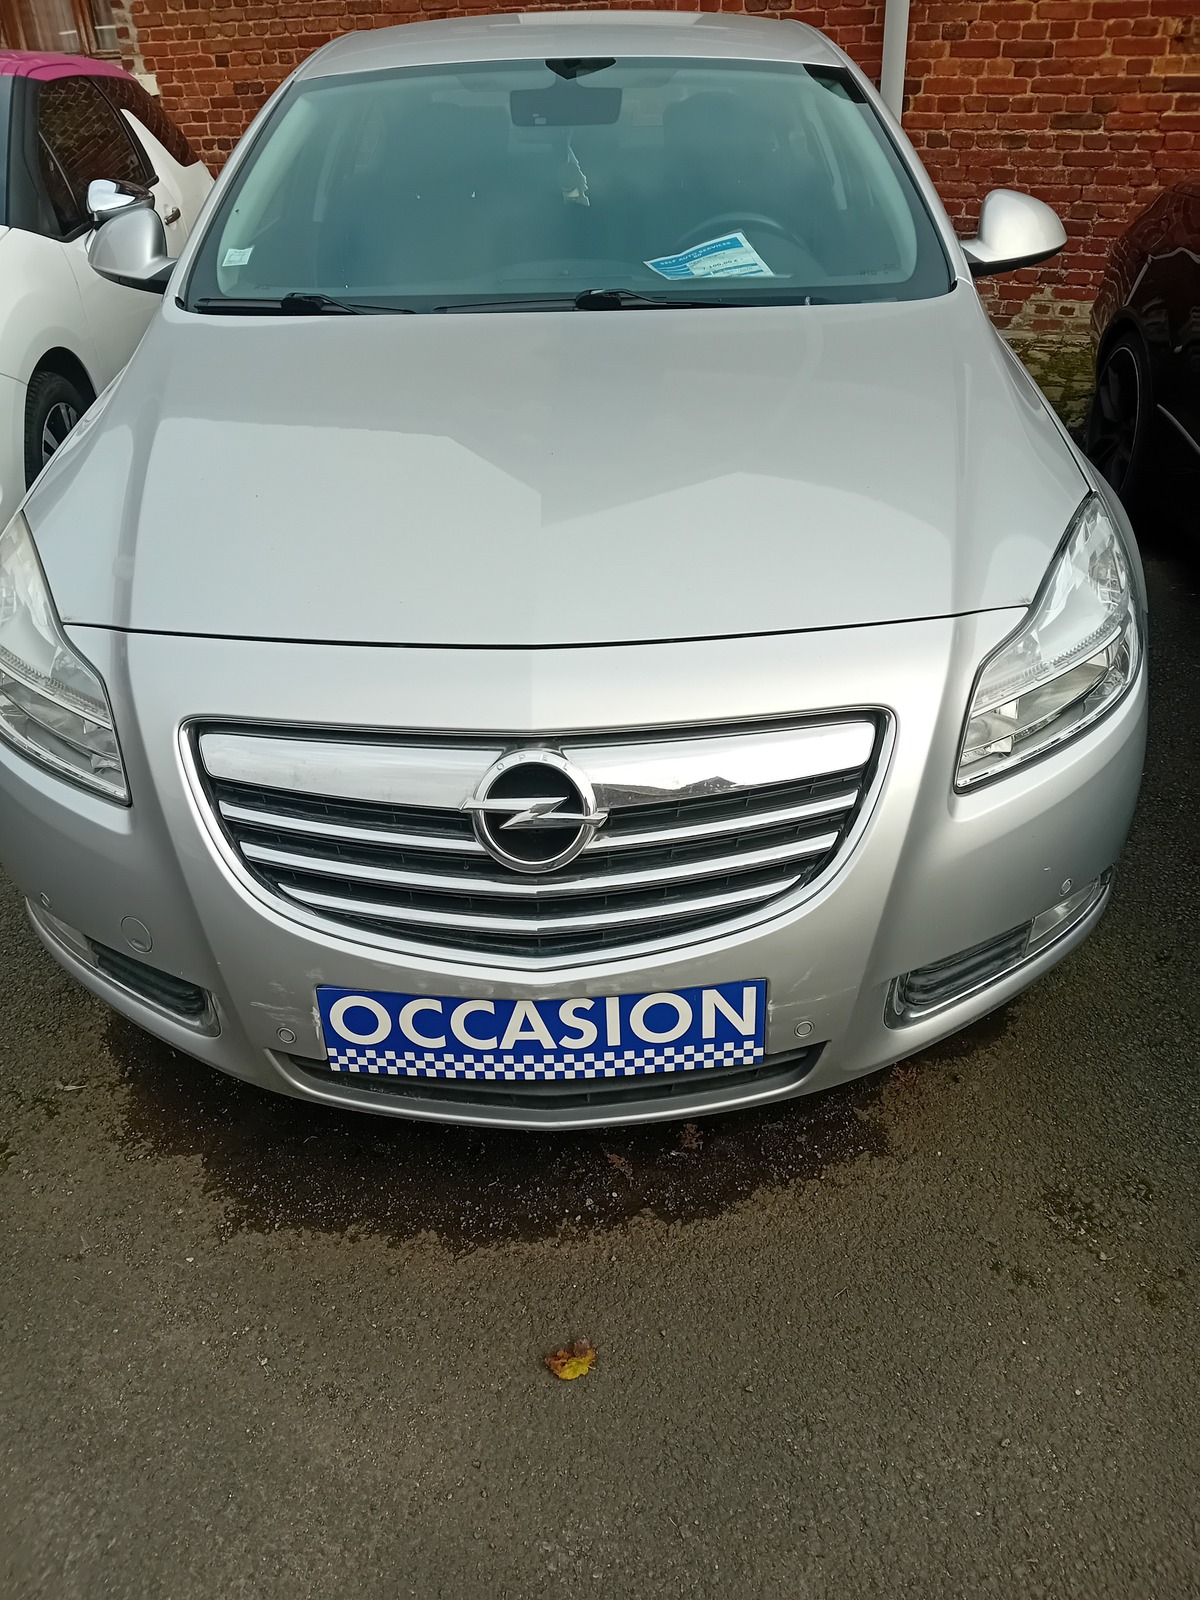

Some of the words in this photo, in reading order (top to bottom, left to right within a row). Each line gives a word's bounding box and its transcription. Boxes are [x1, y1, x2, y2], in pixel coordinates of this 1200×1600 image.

[678, 252, 697, 262] AUTO
[698, 241, 732, 254] SERVICES
[497, 754, 568, 771] OPEL
[329, 986, 757, 1050] OCCASION
